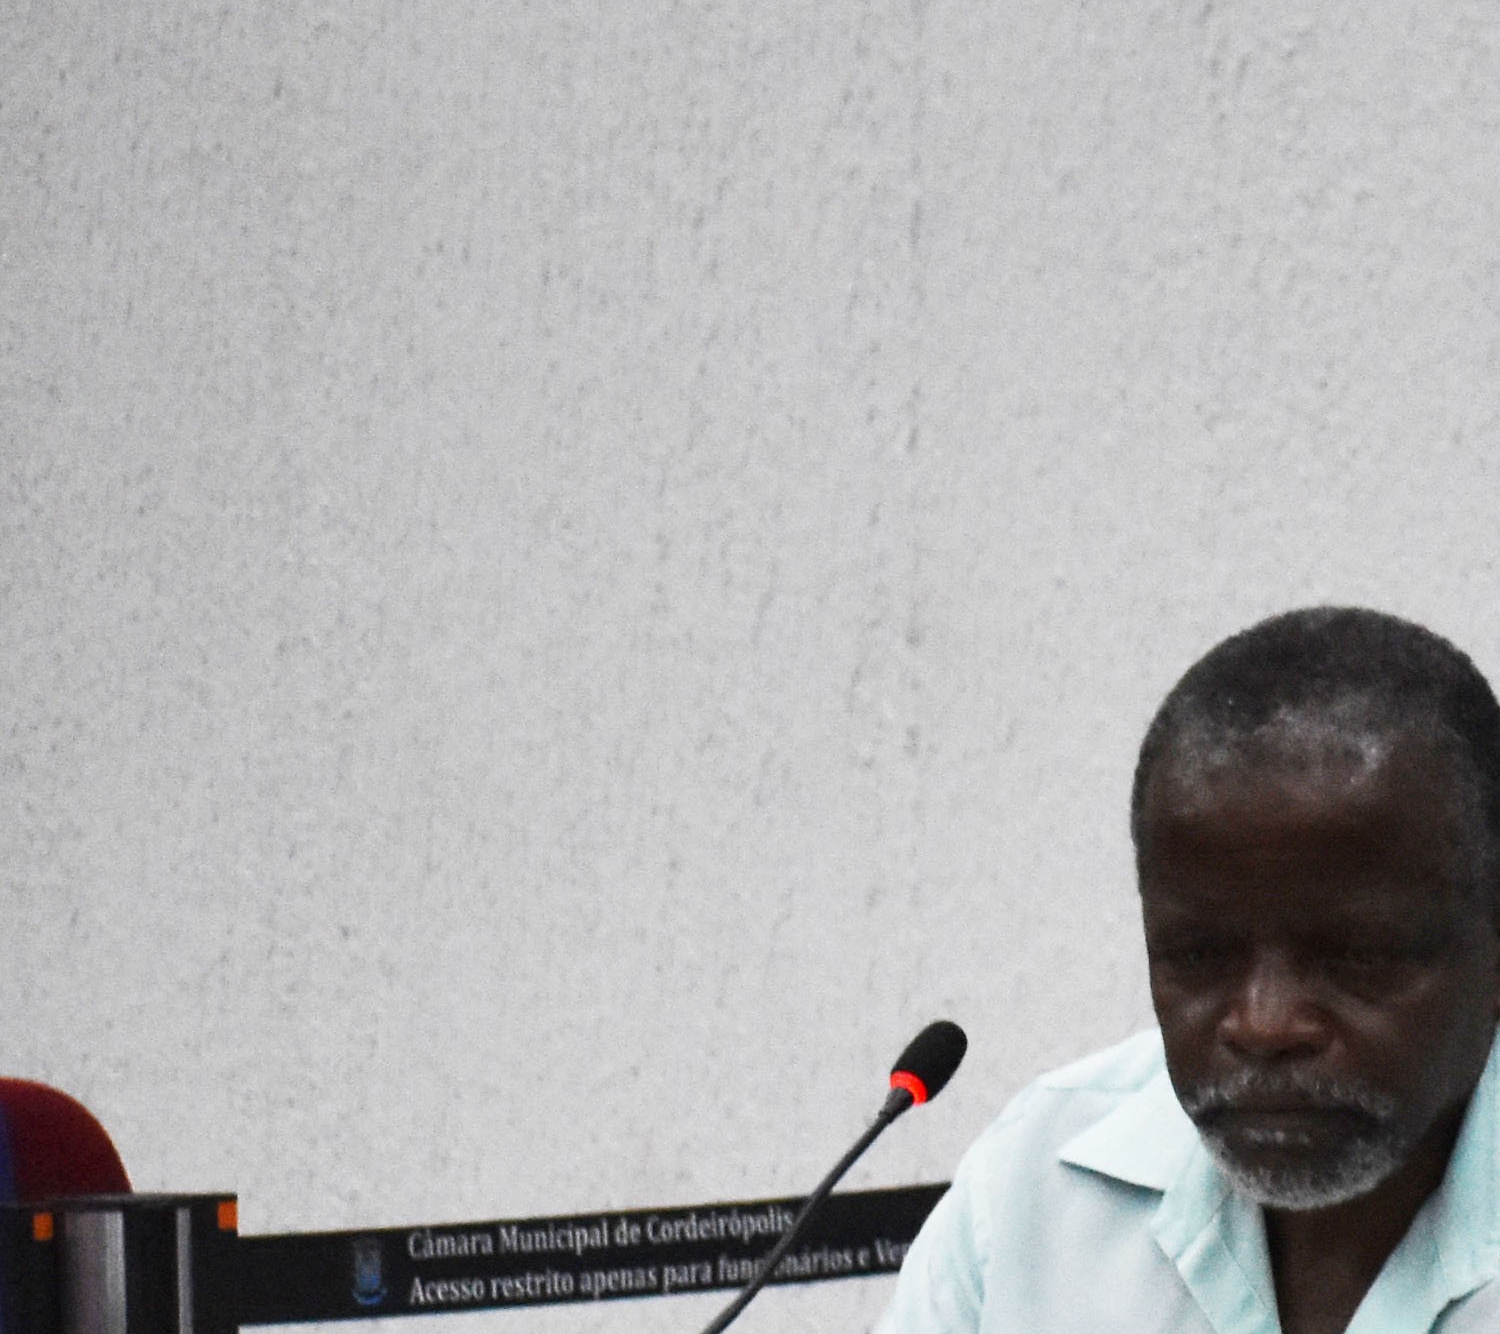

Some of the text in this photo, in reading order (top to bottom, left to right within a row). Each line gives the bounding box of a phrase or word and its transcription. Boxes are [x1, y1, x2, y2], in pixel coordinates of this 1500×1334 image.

[408, 1204, 795, 1259] Câmara Municipal de Cordeirópolis
[410, 1276, 486, 1305] Acesso
[491, 1268, 575, 1299] restrito
[580, 1267, 658, 1301] apenas
[663, 1262, 713, 1293] para
